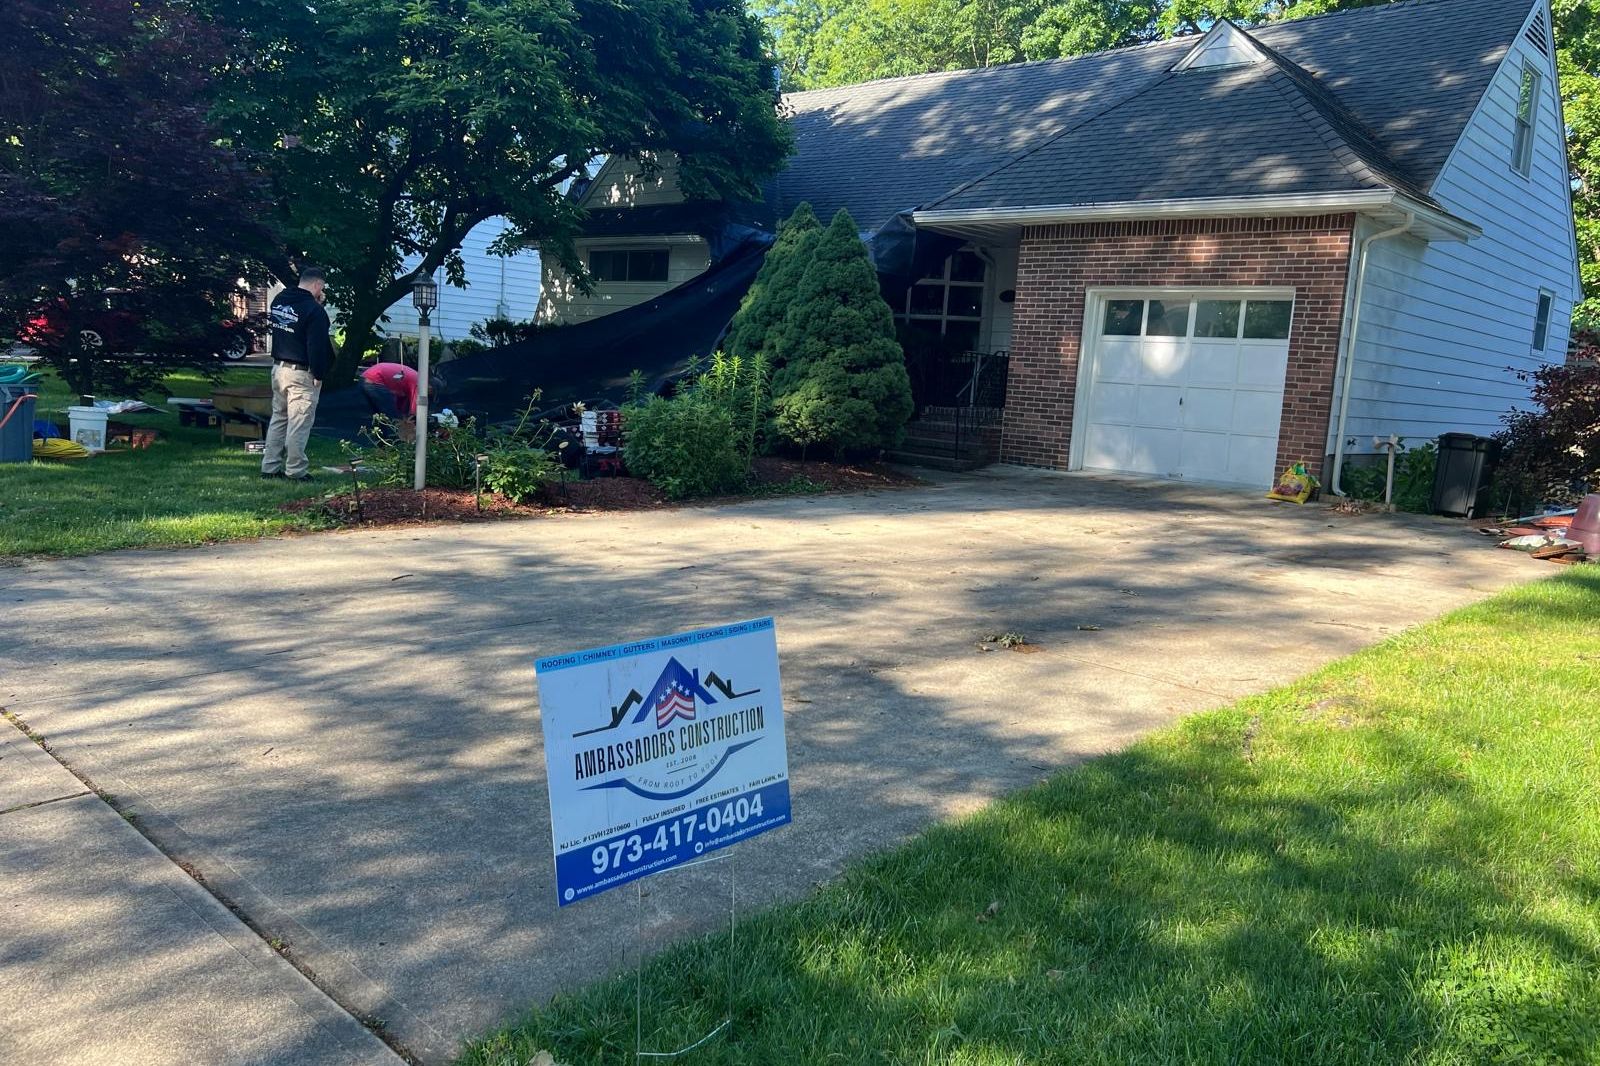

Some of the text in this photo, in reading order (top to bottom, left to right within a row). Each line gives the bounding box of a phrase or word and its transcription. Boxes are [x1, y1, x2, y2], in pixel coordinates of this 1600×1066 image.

[542, 619, 771, 669] ROOFING CHIMNEY GUTTERS MASONRY DECKING SIDING STAIRS
[575, 705, 764, 780] AMBASSADORS CONSTRUCTION
[638, 776, 661, 789] FROM
[689, 772, 698, 782] TO
[749, 780, 760, 788] FAIR
[695, 787, 739, 805] FREE ESTIMATES
[642, 804, 686, 823] FULLY INSURED
[591, 793, 764, 874] 973-417-0404
[576, 855, 678, 894] www.ambassadorsconstruction.com
